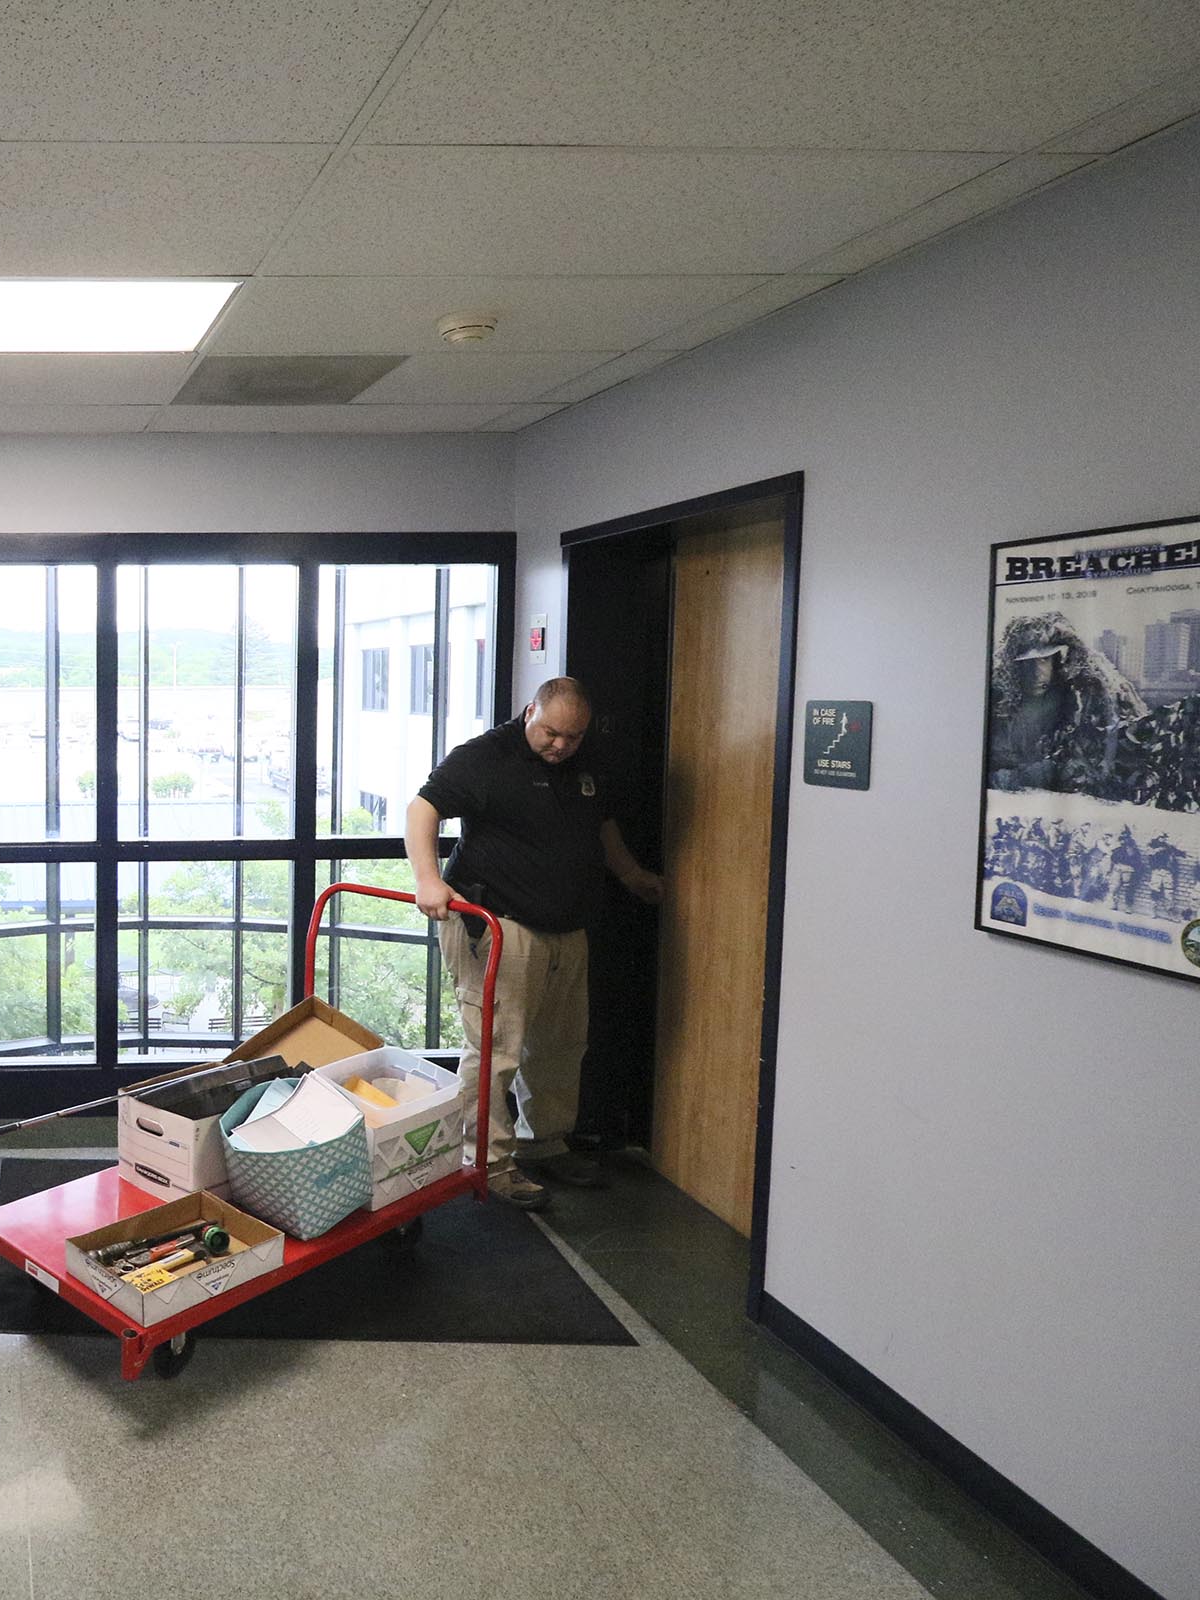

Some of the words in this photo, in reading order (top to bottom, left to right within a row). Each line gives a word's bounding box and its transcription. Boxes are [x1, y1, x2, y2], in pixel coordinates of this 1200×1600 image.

[1074, 543, 1166, 561] INTERNATIONAL
[1005, 540, 1200, 581] BREACHE
[1085, 567, 1152, 580] SYMPOSIUM
[813, 708, 819, 716] IN
[820, 708, 836, 717] CASE
[813, 717, 821, 725] OF
[822, 717, 835, 726] FIRE
[817, 759, 829, 768] USE
[831, 760, 852, 770] STAIRS
